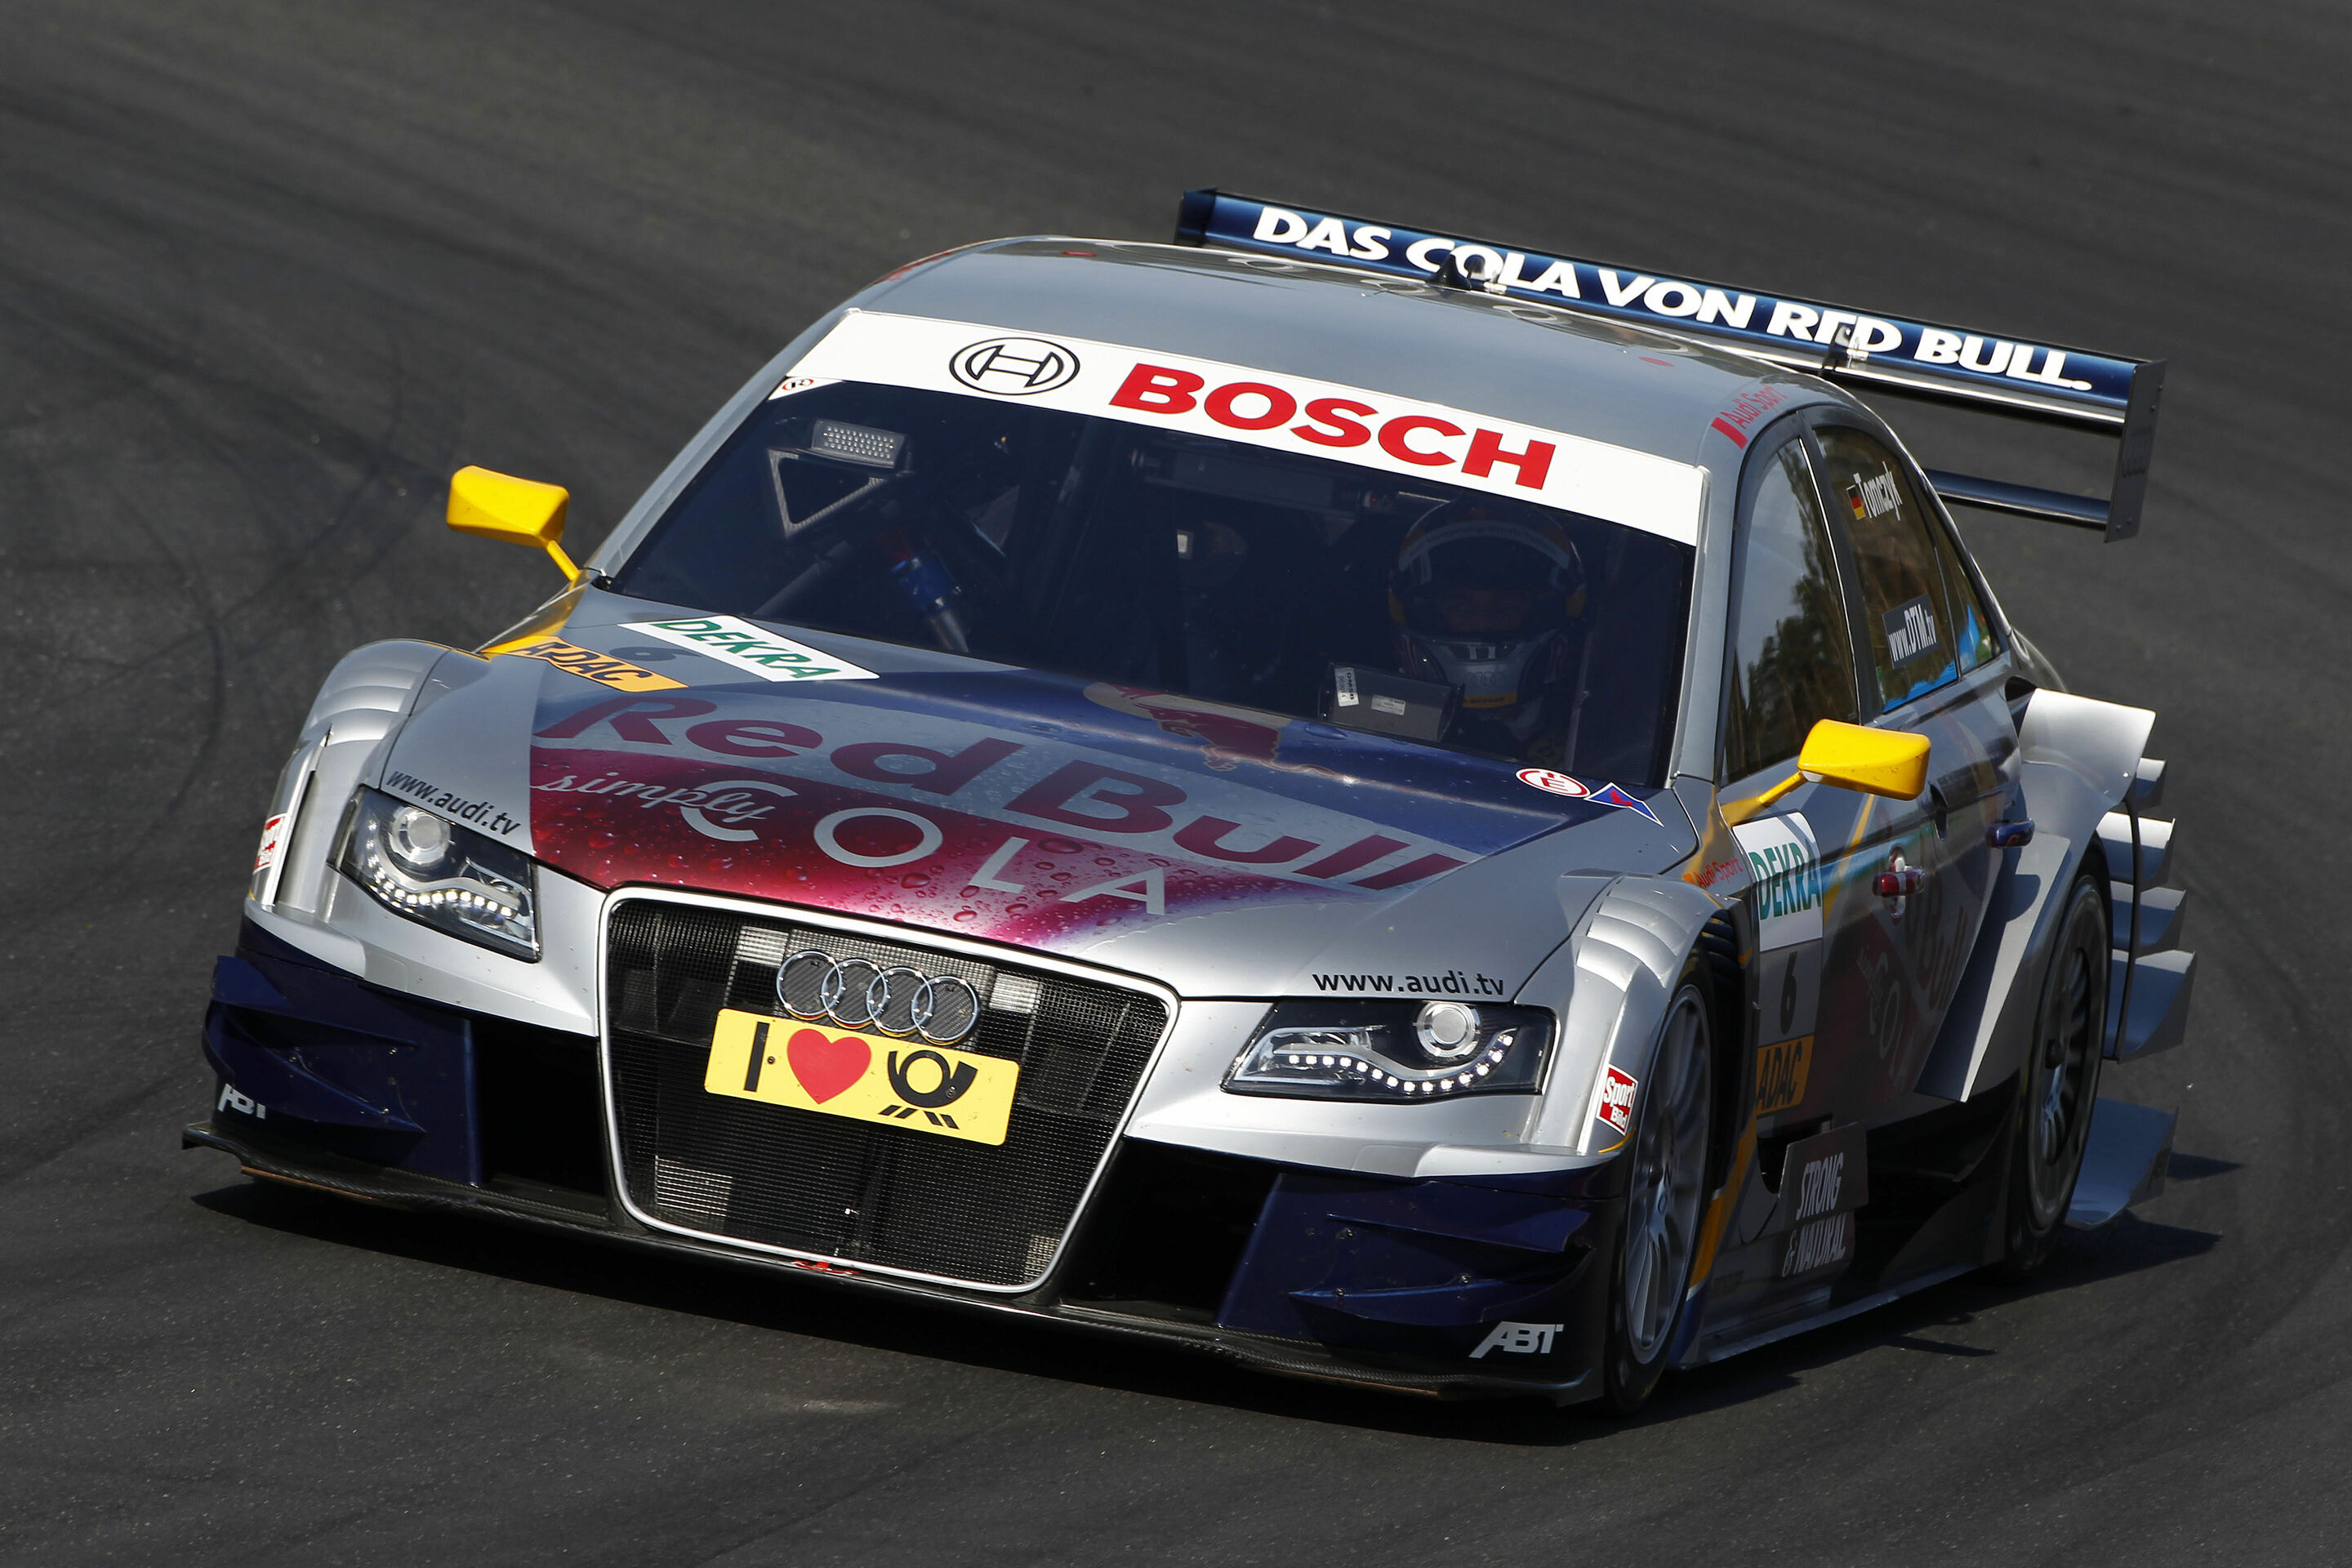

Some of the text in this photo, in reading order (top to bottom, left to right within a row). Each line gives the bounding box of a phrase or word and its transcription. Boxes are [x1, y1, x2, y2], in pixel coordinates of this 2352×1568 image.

[1254, 206, 1392, 261] DAS
[1405, 238, 1582, 299] COLA
[1597, 269, 1757, 328] VON
[1766, 301, 1903, 353] RED
[1110, 362, 1557, 490] BOSCH
[1720, 384, 1788, 430] Audi Sport
[1853, 461, 1904, 521] Tomczyk
[508, 641, 653, 681] ADAC
[653, 620, 841, 679] DEKRA
[1888, 603, 1937, 662] www.DTM.tv
[386, 771, 521, 835] www.audi.tv
[529, 772, 777, 822] simply
[533, 697, 1469, 891] Red Bull
[679, 780, 1165, 915] COLA
[1693, 856, 1744, 888] Audi Sport
[1748, 840, 1821, 920] DEKRA
[1312, 970, 1504, 996] www.audi.tv
[1780, 952, 1797, 1036] 6
[744, 1021, 770, 1093] I
[1757, 1040, 1802, 1109] ADAC
[1603, 1076, 1635, 1107] Sport
[1796, 1152, 1844, 1220] STRONG
[1793, 1212, 1846, 1275] NATURAL
[1468, 1321, 1565, 1358] ABT
